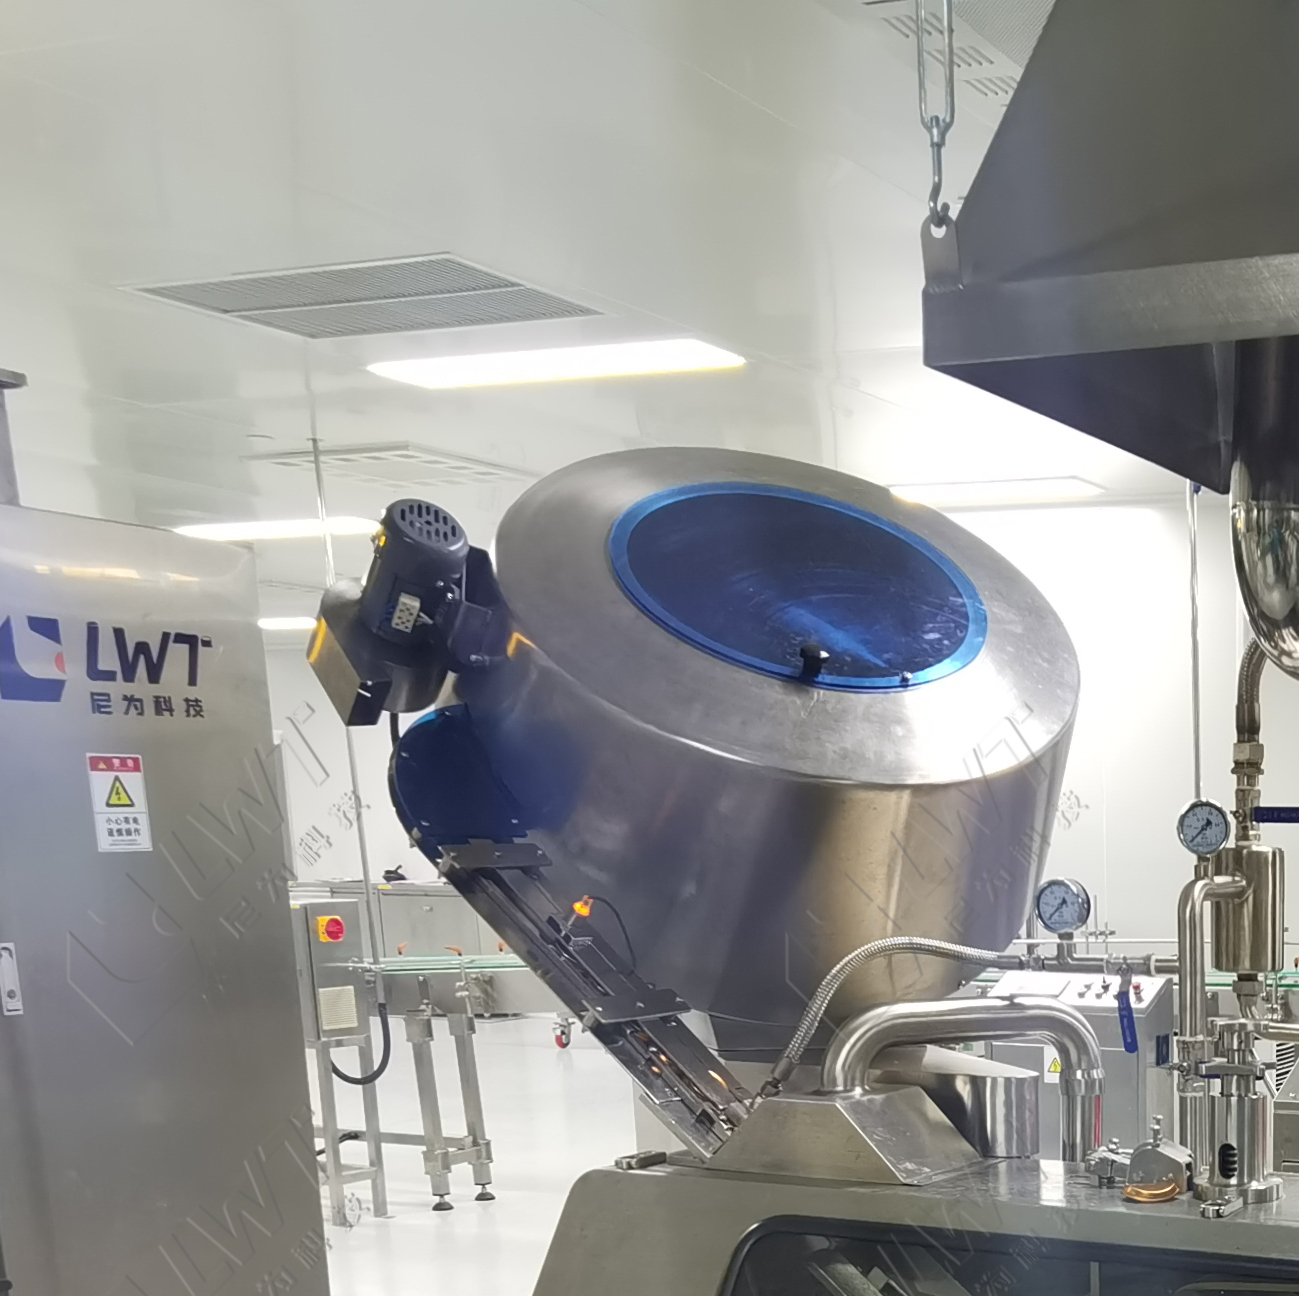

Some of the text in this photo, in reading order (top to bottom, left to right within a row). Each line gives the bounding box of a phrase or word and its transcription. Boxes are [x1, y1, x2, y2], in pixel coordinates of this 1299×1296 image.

[86, 621, 200, 687] LWT
[90, 691, 205, 719] 尼为科技
